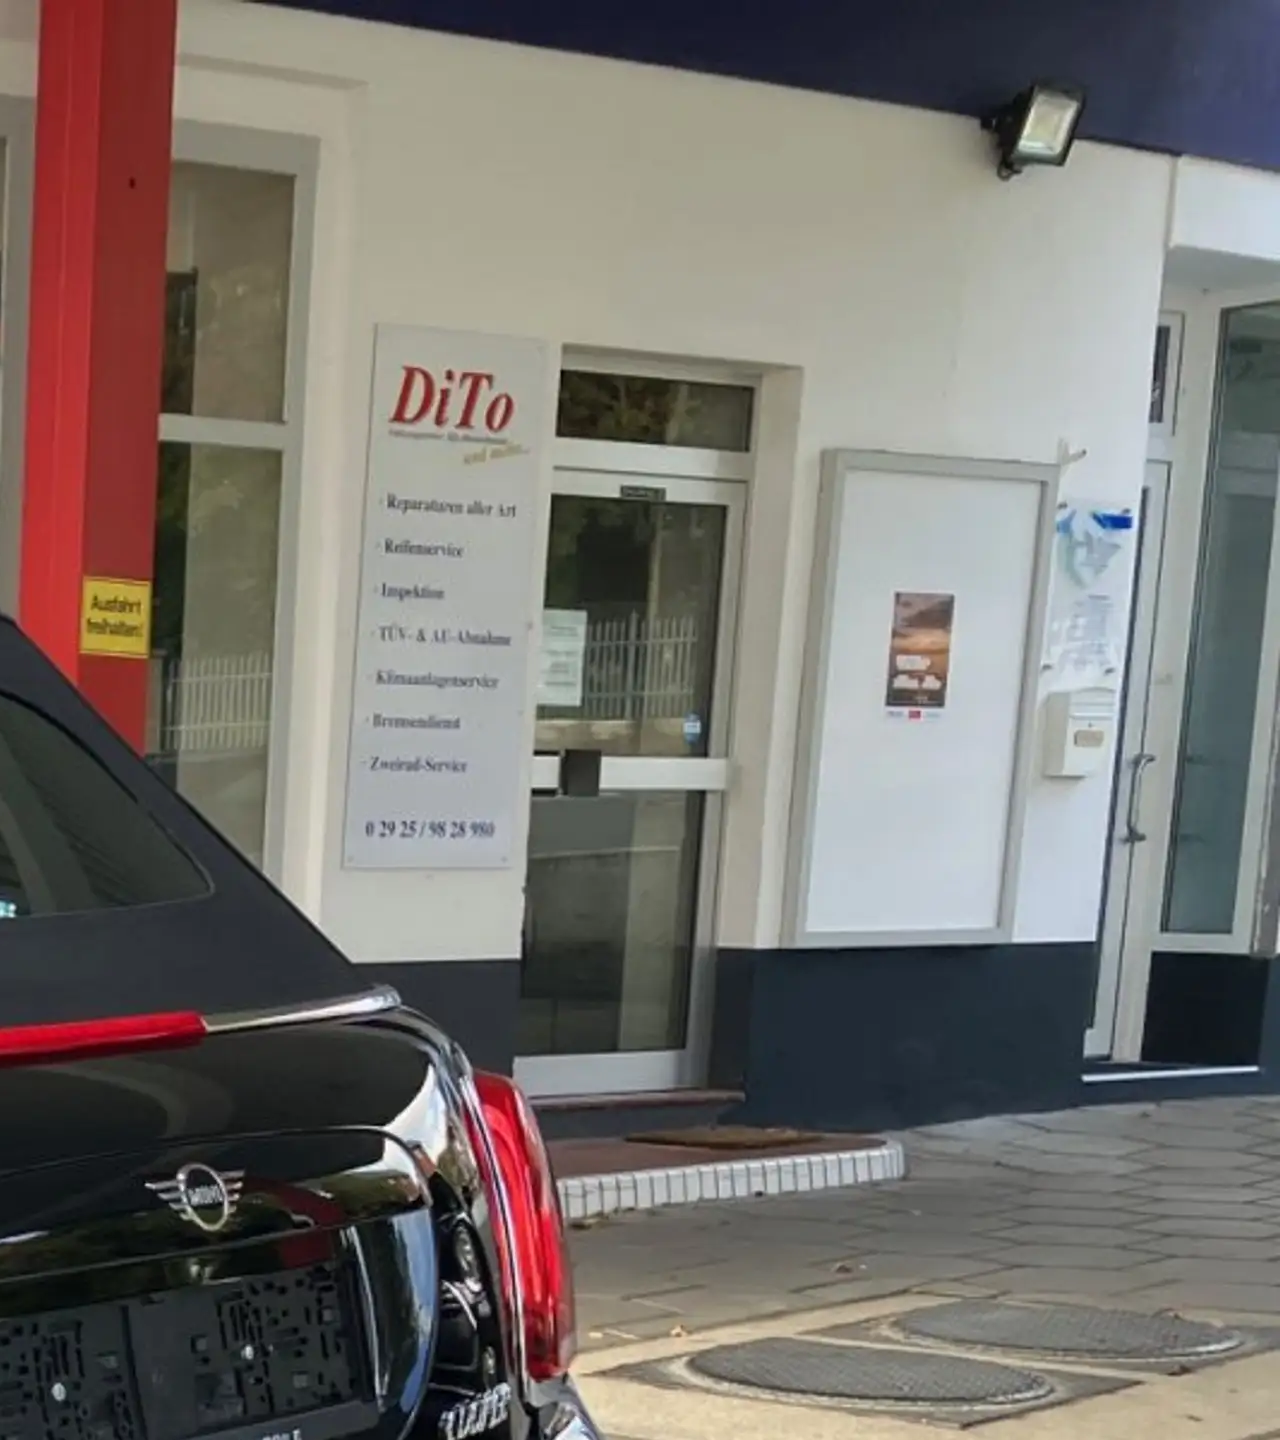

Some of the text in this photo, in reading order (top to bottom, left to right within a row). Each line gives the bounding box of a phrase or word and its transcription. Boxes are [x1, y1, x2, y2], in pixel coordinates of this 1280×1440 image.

[389, 364, 515, 433] DiTo
[386, 493, 463, 516] Reparaturen
[384, 537, 464, 558] Reifenservice
[381, 582, 445, 601] Inspektion
[90, 594, 142, 615] Ausfahrt
[415, 628, 427, 642] &
[369, 756, 468, 773] Zweirad-Service
[365, 820, 375, 838] 0
[378, 820, 396, 838] 29
[399, 820, 417, 838] 25
